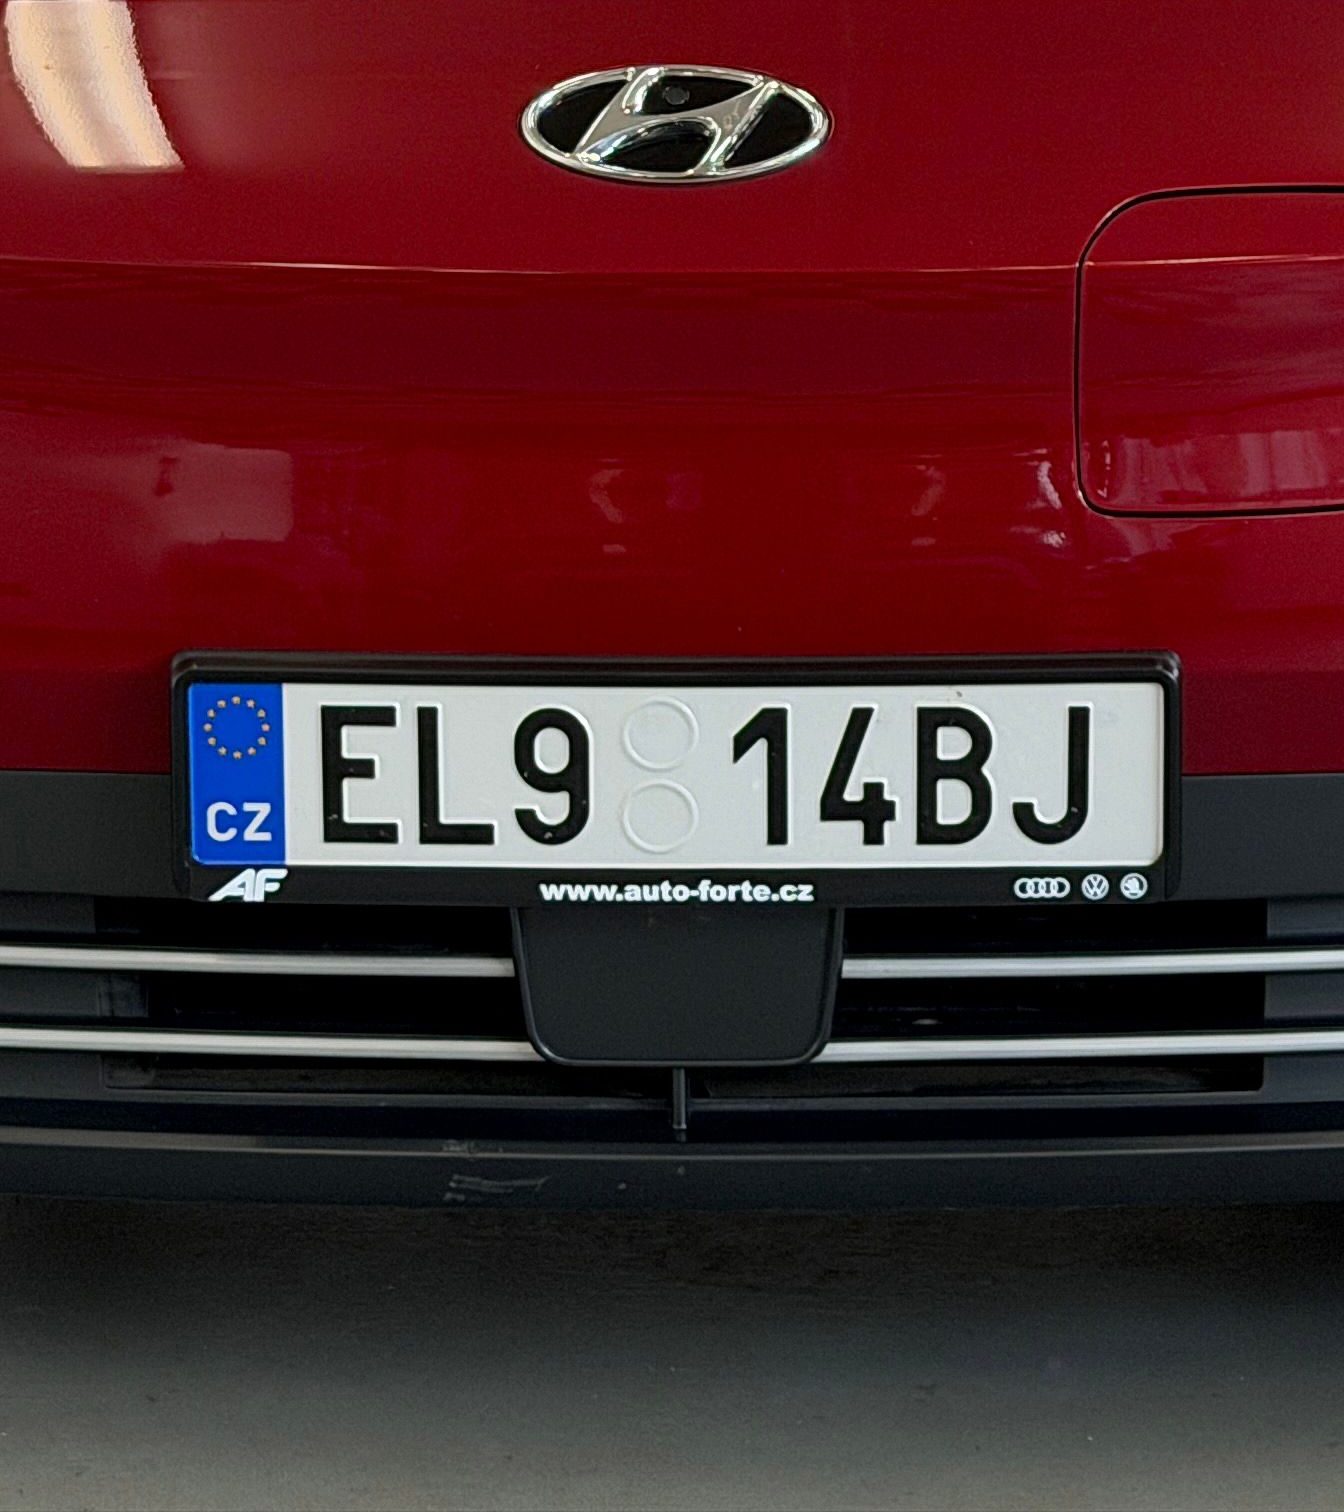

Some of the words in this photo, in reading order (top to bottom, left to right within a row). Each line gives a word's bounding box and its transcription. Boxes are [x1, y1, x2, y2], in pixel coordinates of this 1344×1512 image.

[320, 705, 590, 846] EL9
[732, 706, 1090, 846] 14BJ
[206, 801, 273, 842] CZ
[208, 868, 288, 902] AF
[539, 879, 815, 902] www.auto-forte.cz
